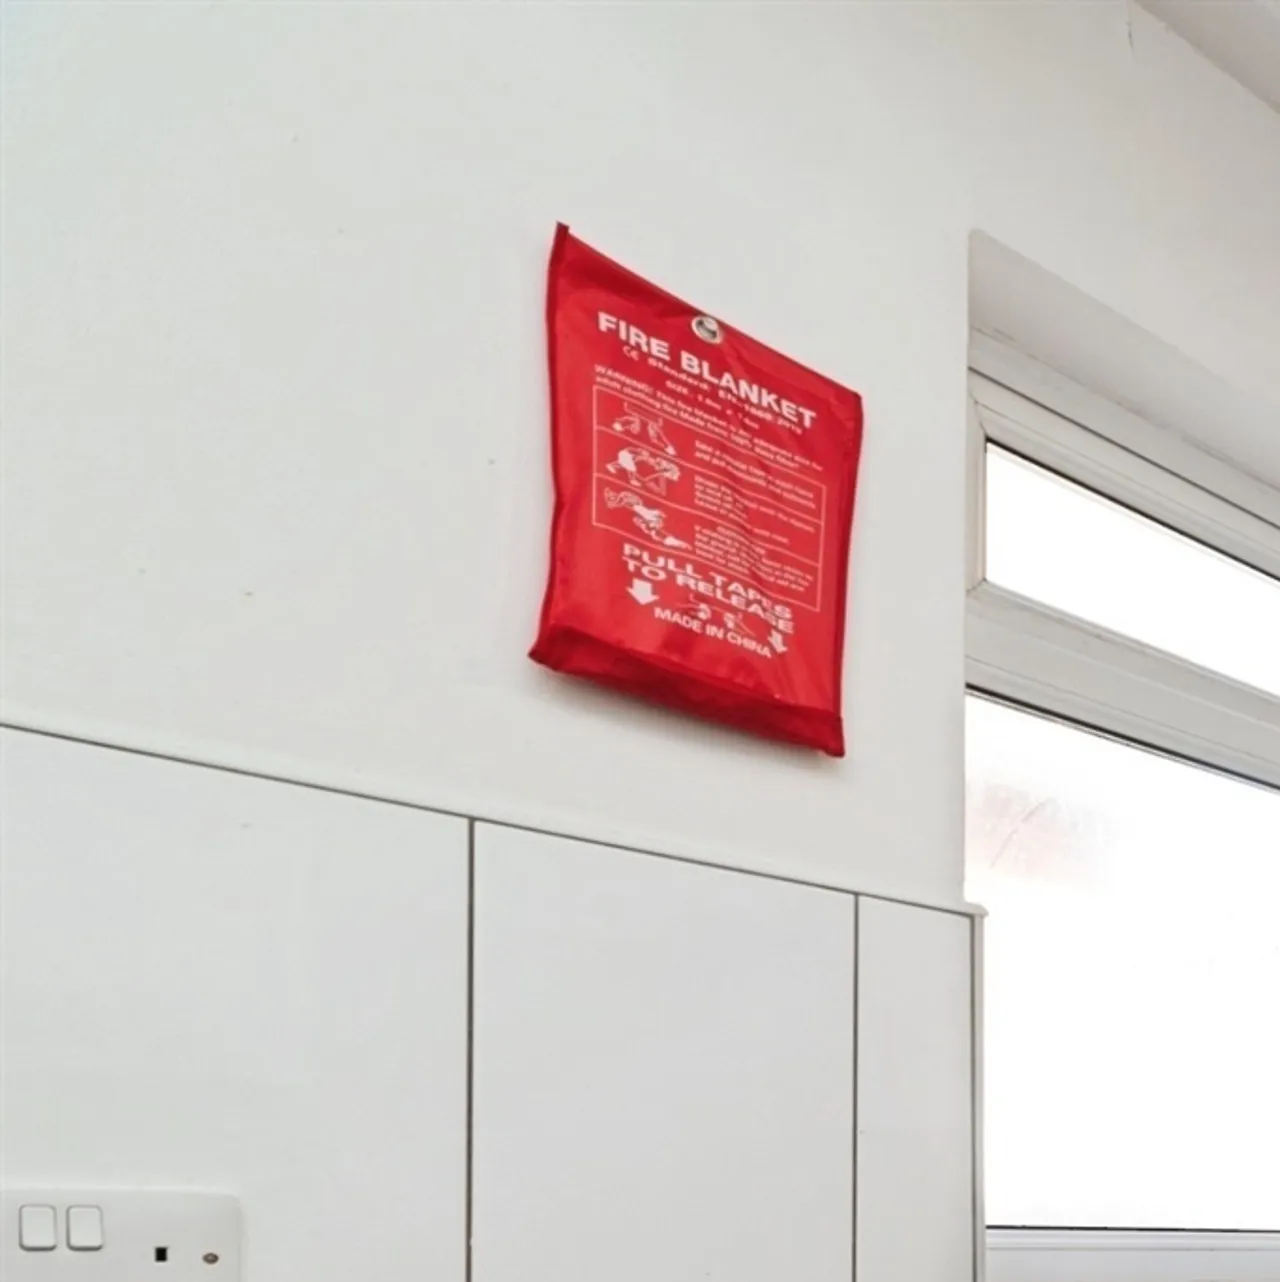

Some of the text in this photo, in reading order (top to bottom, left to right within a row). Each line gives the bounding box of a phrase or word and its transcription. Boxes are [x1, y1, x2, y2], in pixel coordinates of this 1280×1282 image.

[598, 311, 816, 428] FIRE BLANKET
[622, 543, 702, 578] PULL
[709, 572, 792, 619] TAPES
[622, 556, 667, 581] TO
[676, 574, 794, 633] RELEASE
[654, 607, 772, 659] MADE IN CHINA
